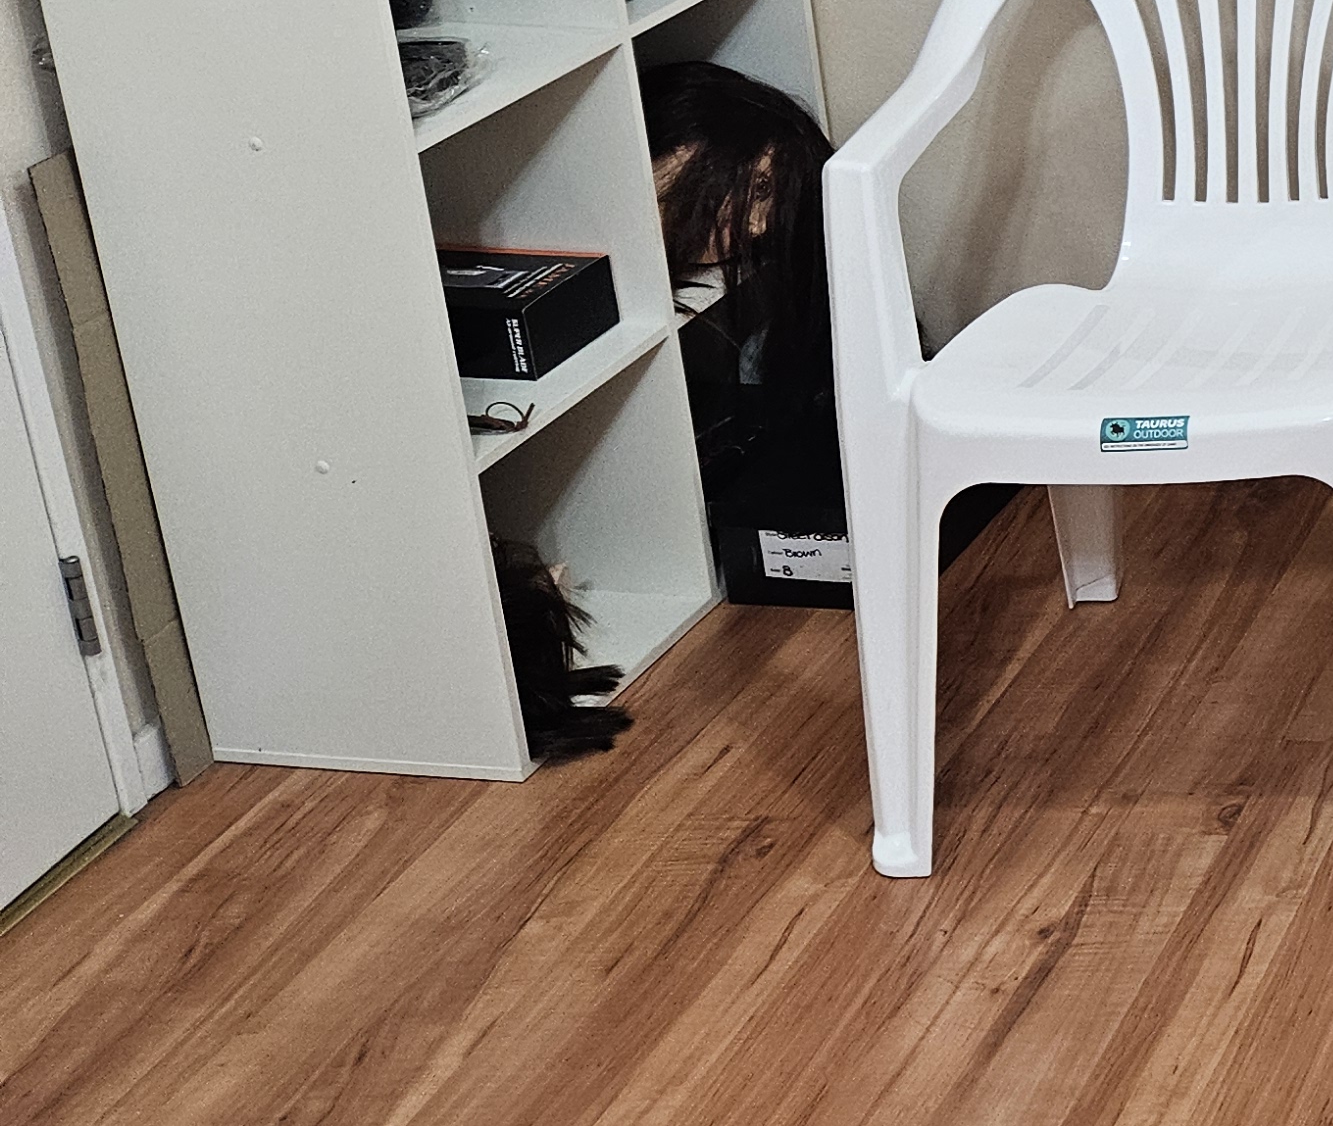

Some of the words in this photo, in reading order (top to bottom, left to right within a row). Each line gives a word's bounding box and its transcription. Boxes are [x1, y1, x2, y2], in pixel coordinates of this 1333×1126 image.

[1135, 418, 1185, 429] TAURUS
[1133, 428, 1184, 440] OUTDOOR
[782, 548, 822, 558] Brown
